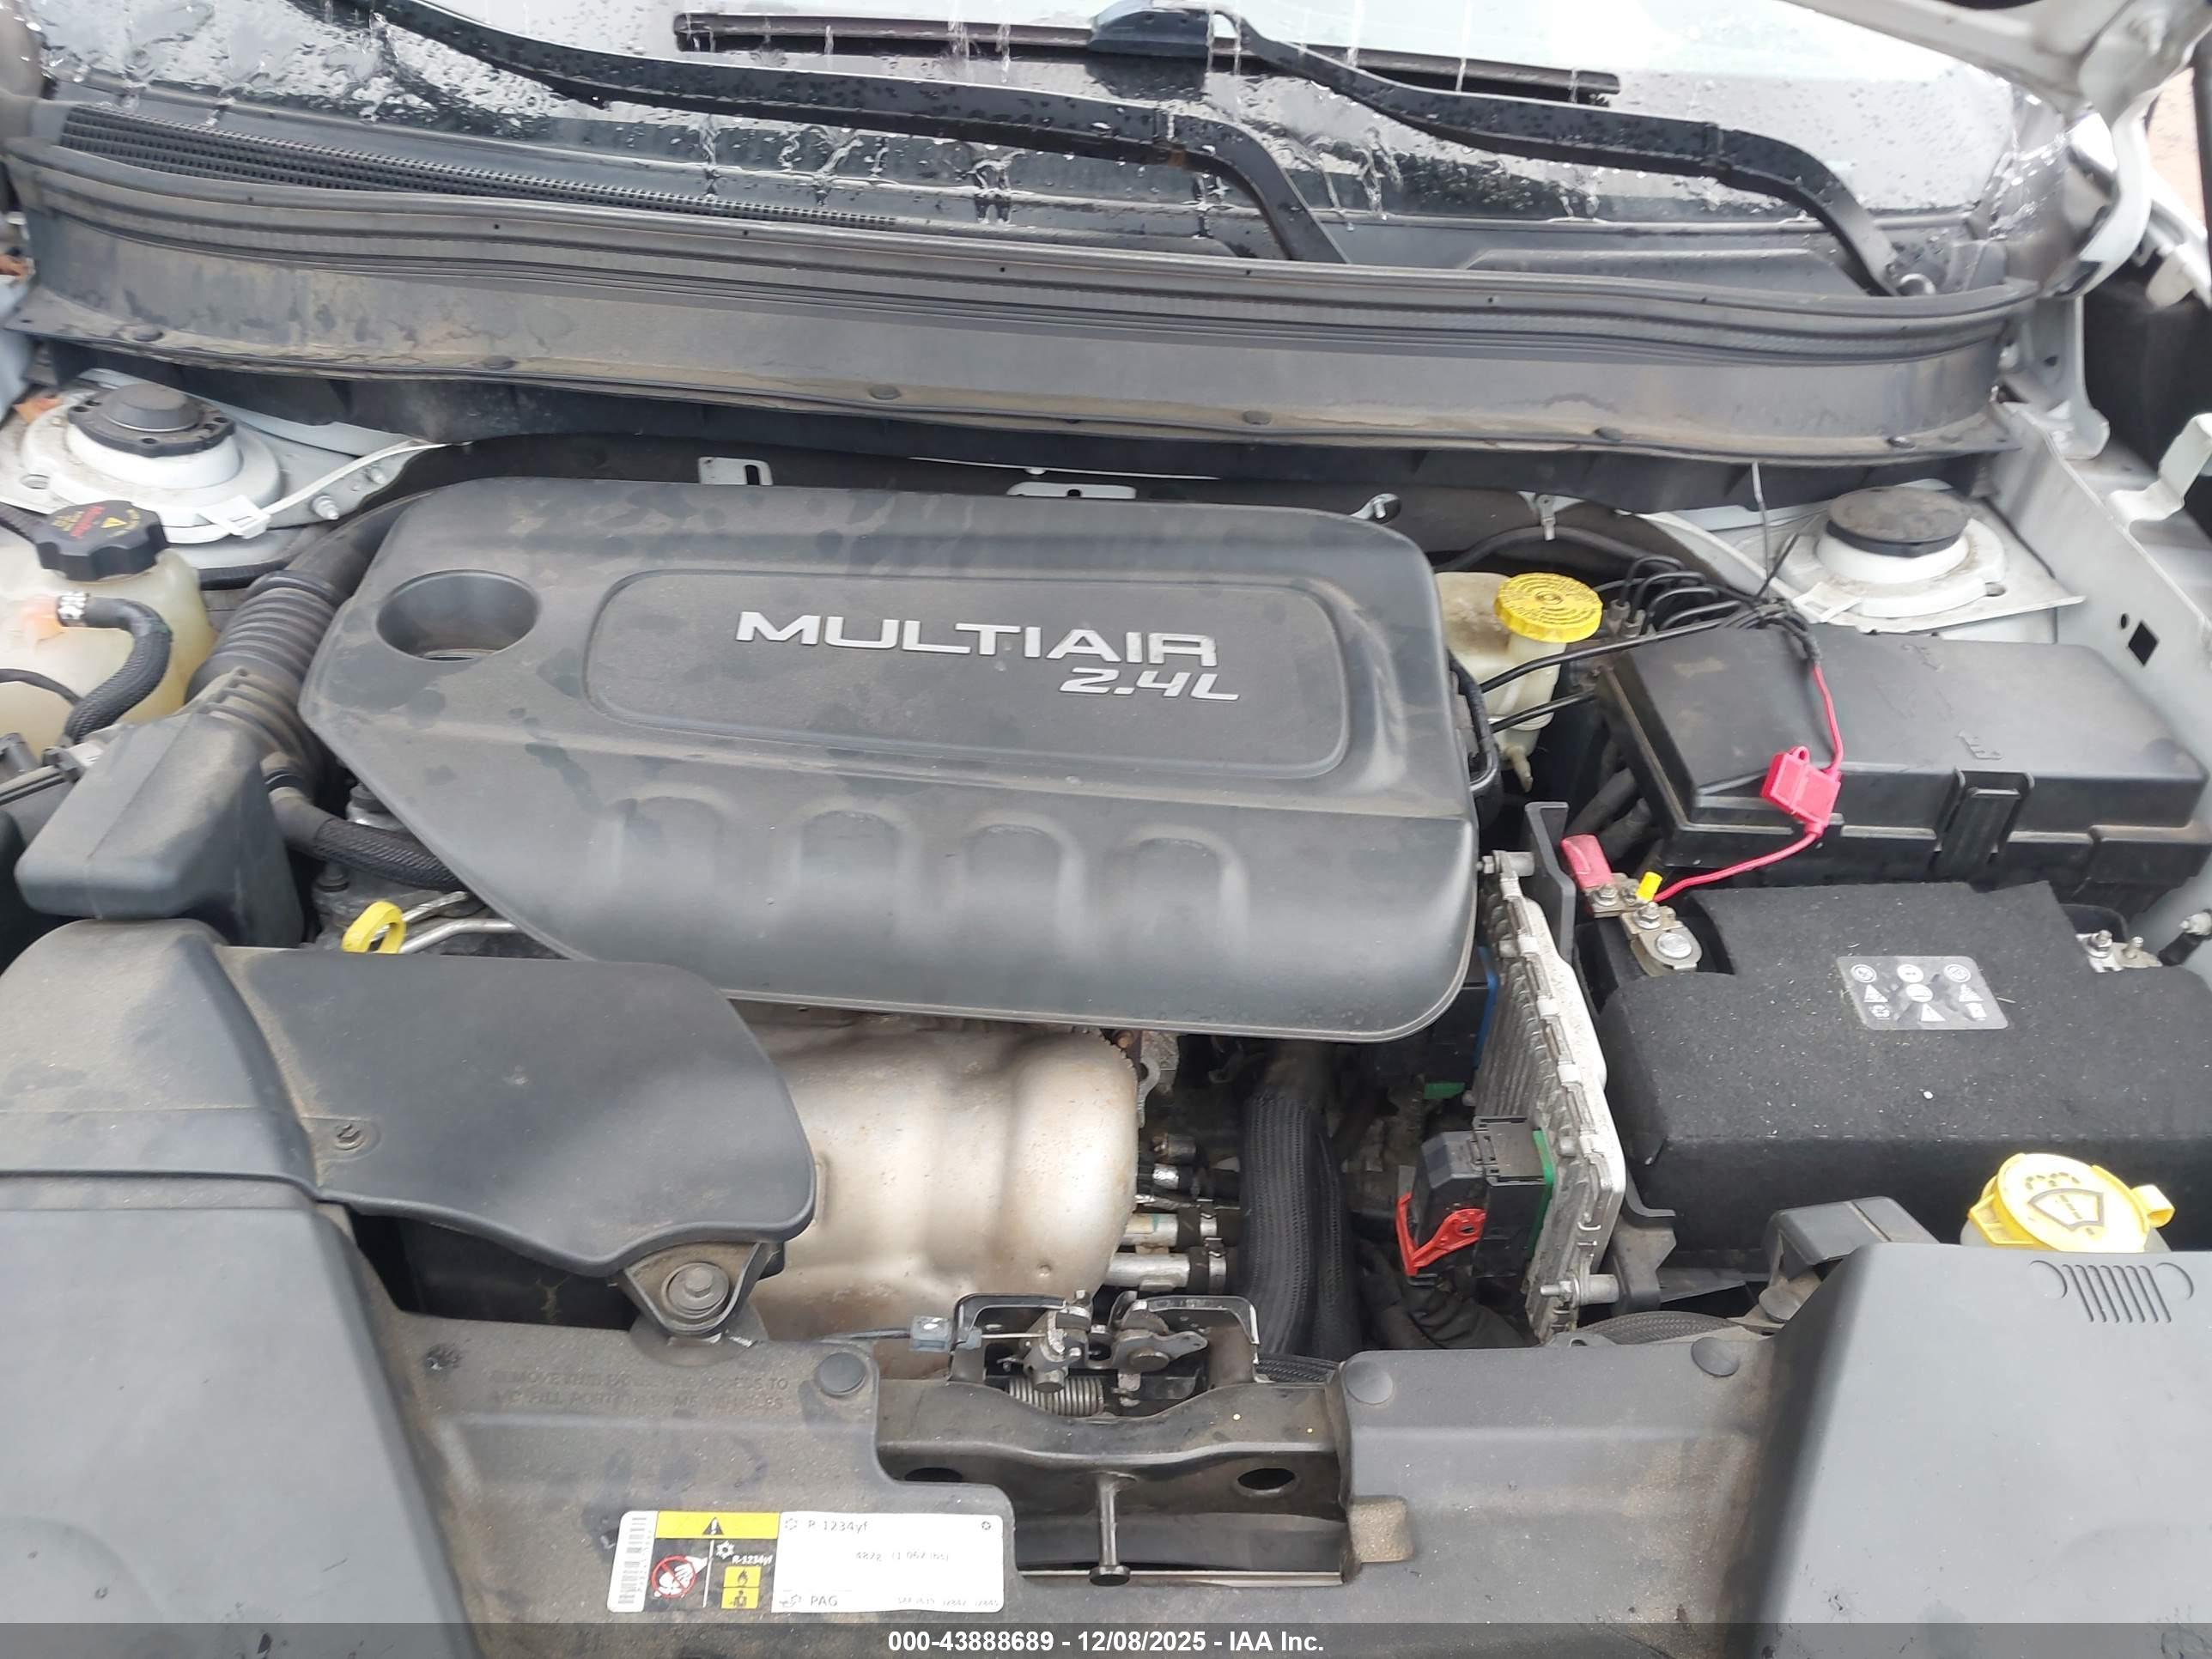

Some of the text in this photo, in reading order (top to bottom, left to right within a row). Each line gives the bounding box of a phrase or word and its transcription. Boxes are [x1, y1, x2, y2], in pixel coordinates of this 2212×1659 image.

[736, 611, 1218, 667] MULTIAIR
[1059, 666, 1239, 702] 2.4L
[810, 1595, 839, 1607] PAG
